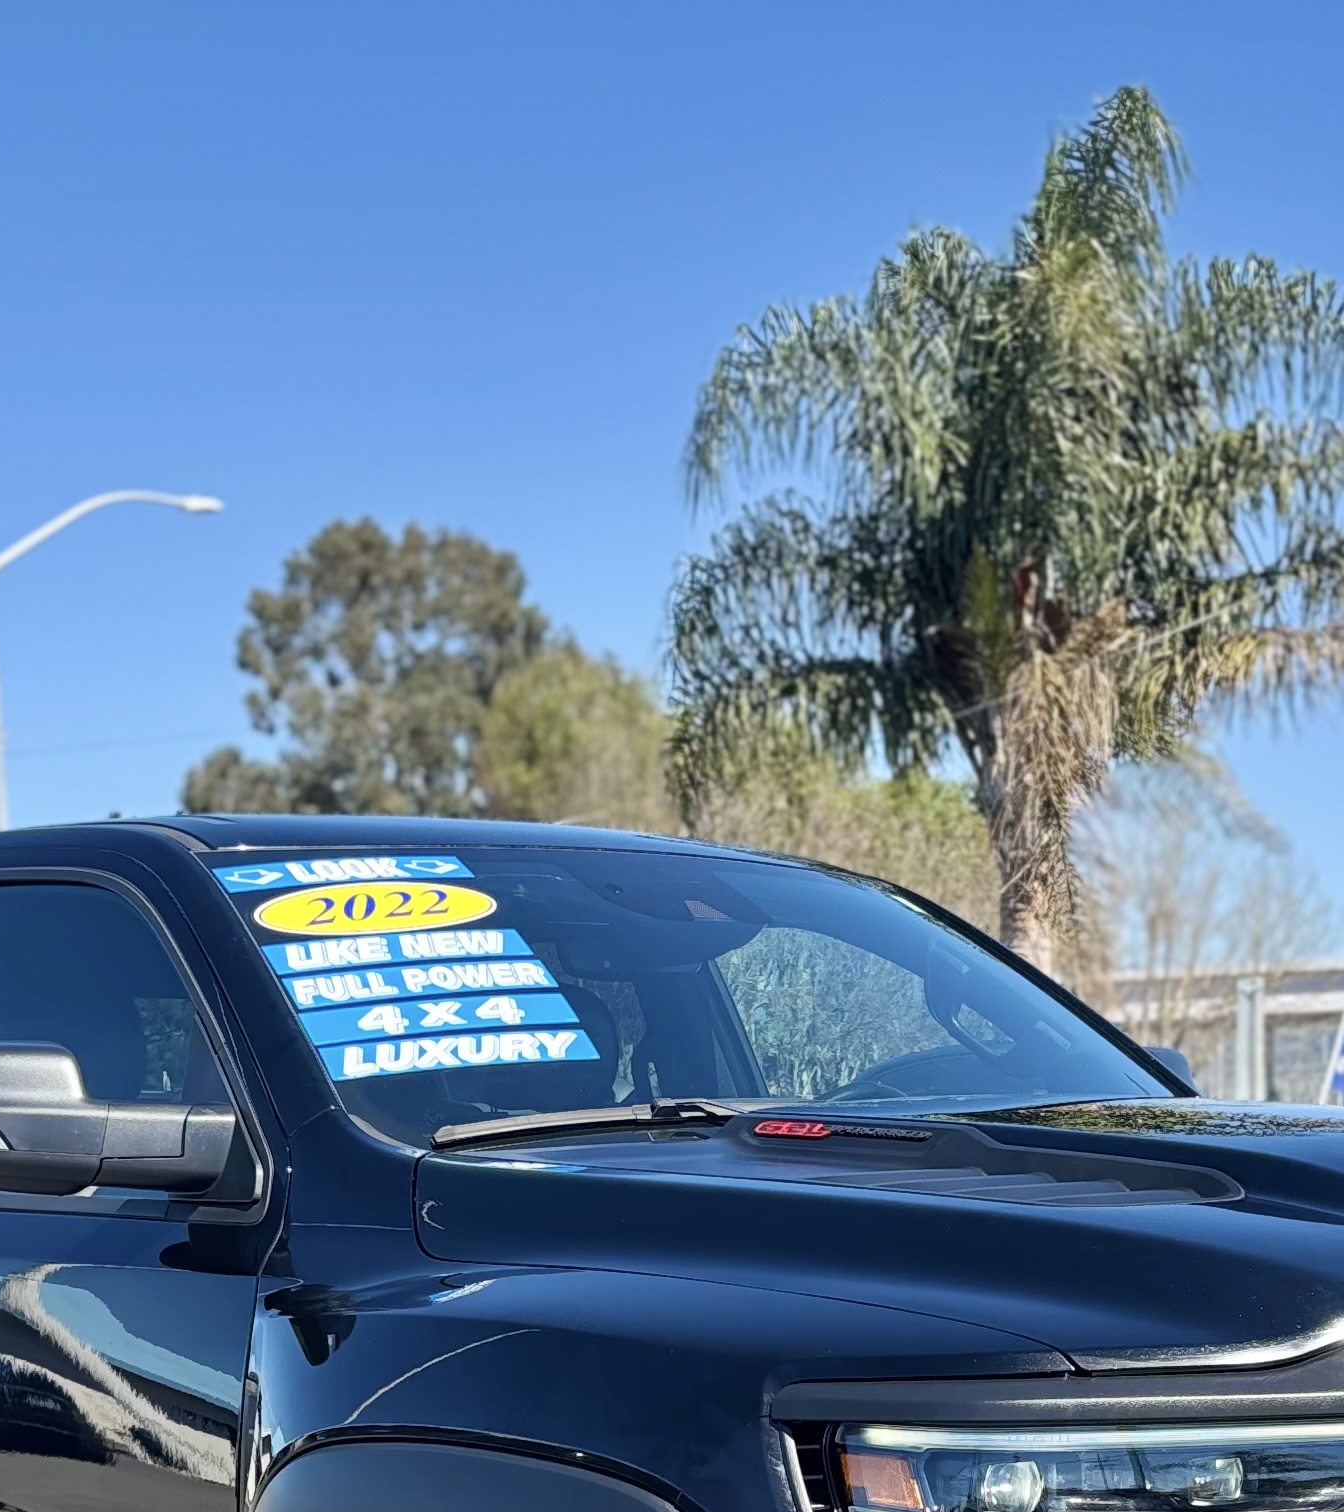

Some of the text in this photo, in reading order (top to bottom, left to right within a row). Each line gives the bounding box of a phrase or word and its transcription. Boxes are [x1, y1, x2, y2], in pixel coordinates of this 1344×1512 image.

[285, 857, 412, 883] LOOK
[305, 889, 450, 926] 2022
[285, 930, 504, 970] LIKE NEW
[292, 961, 549, 1007] FULL POWER
[343, 1031, 578, 1079] LUXURY
